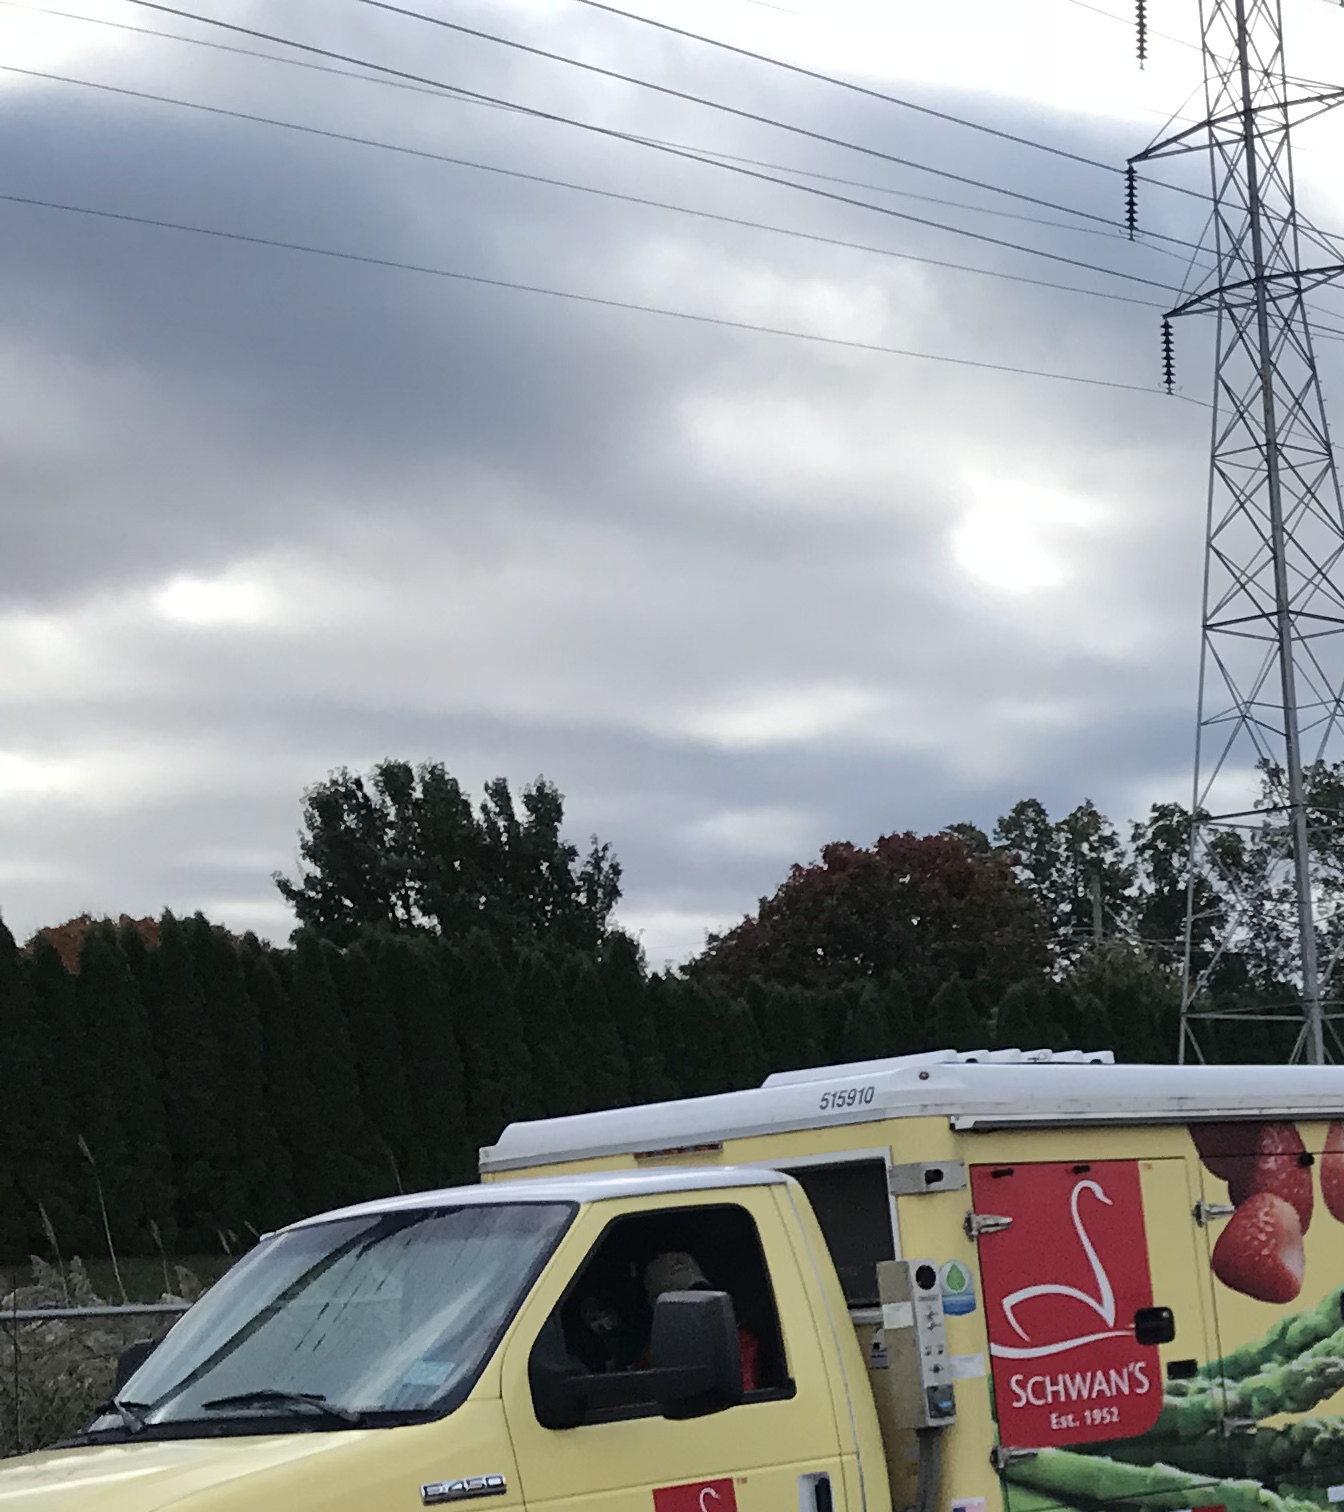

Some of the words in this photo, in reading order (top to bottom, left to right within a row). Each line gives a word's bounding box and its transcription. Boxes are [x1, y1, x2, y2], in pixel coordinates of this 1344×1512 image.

[819, 1086, 875, 1110] 515910
[1010, 1361, 1150, 1409] SCHWAN'S
[1050, 1411, 1080, 1430] Est.
[1084, 1406, 1121, 1426] 1952
